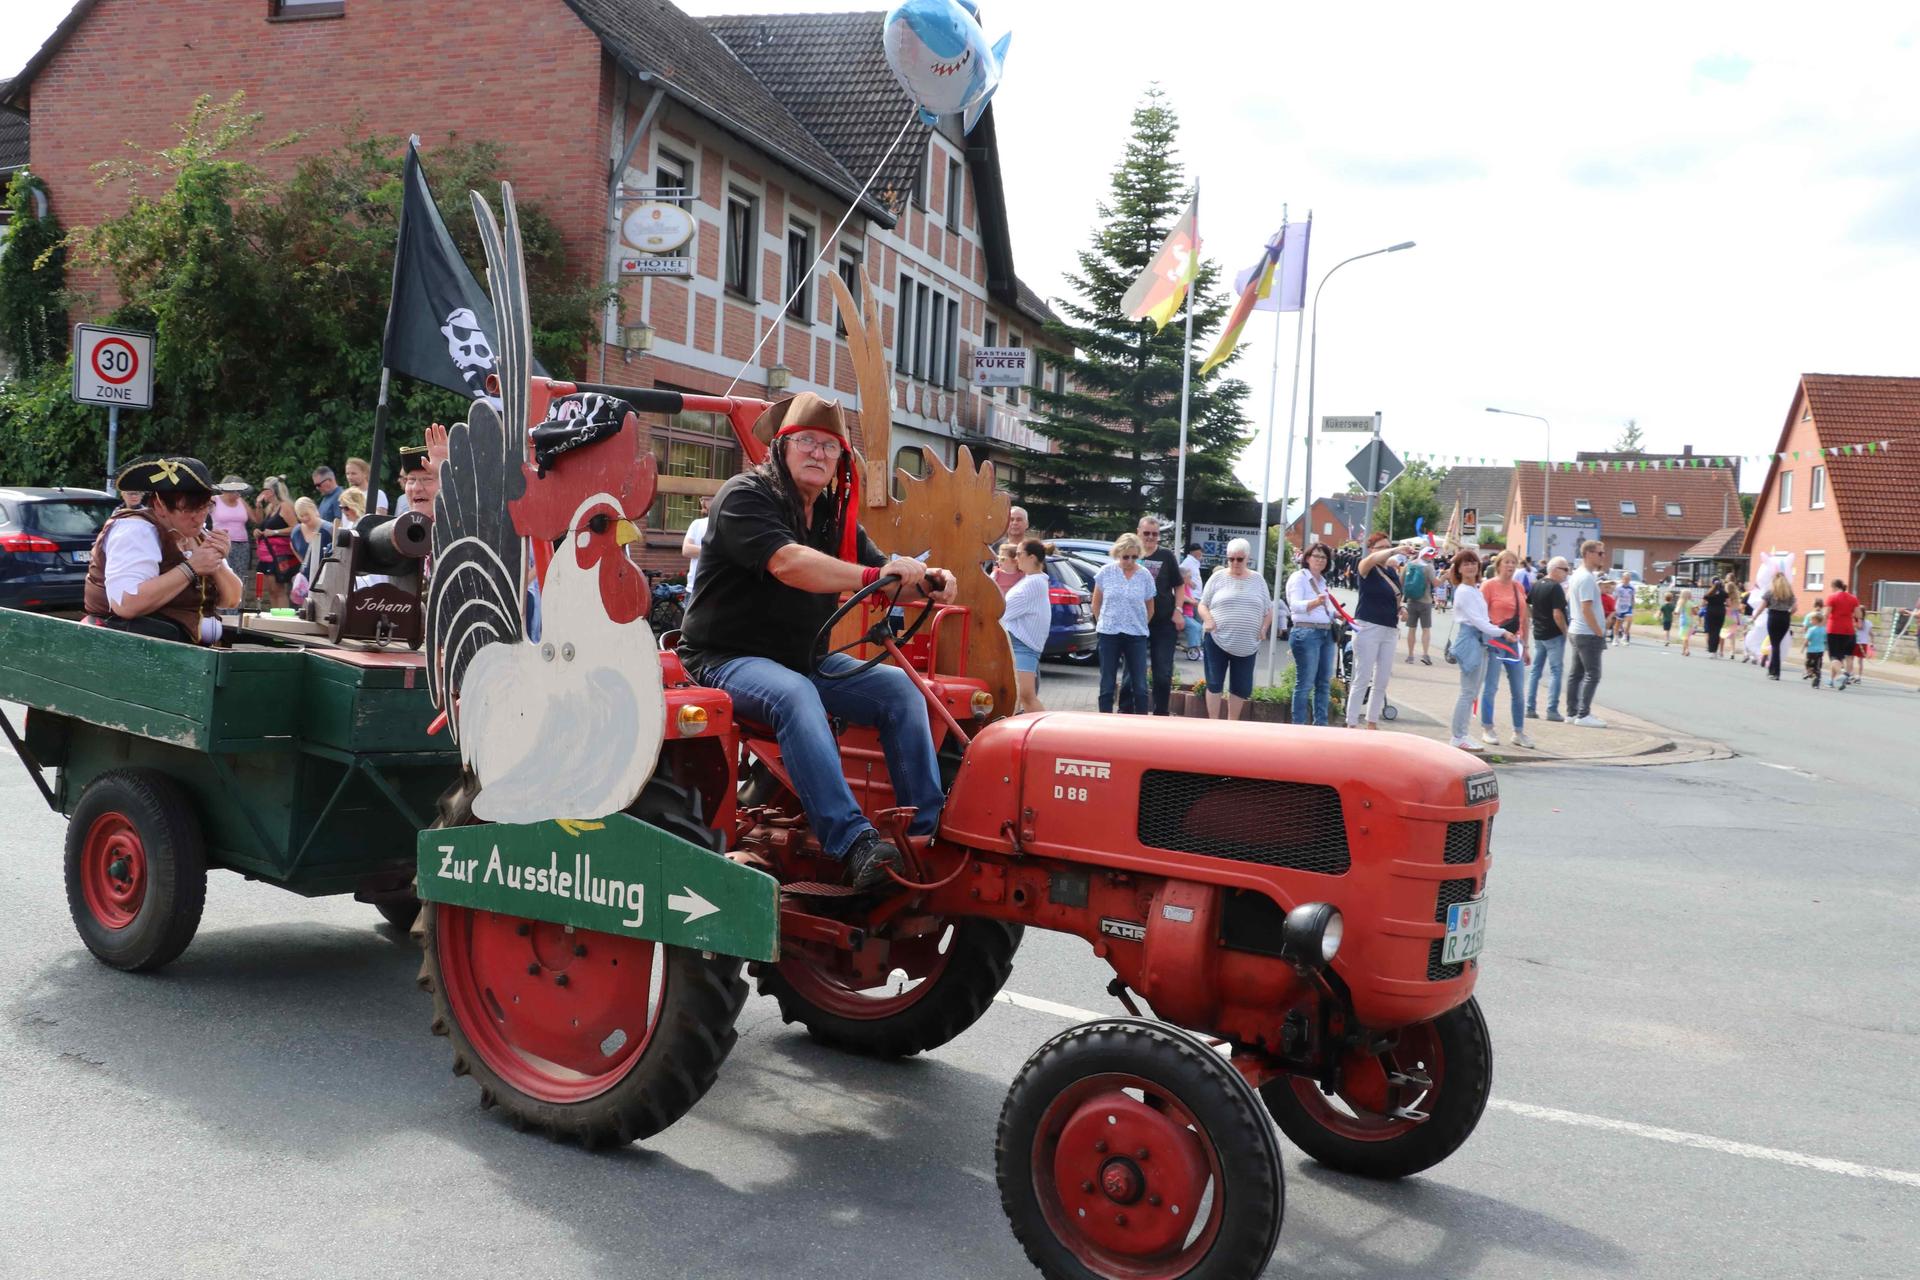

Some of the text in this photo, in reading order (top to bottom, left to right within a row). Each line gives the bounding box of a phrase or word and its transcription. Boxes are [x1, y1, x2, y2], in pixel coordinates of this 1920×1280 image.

[102, 349, 129, 372] 30
[96, 385, 132, 400] ZONE
[1325, 418, 1369, 431] Kükersweg
[355, 597, 412, 613] Johann
[1055, 757, 1111, 780] FAHR
[1054, 785, 1063, 799] D
[1467, 774, 1498, 801] FAHR
[437, 843, 645, 928] Zur Ausstellung
[1101, 919, 1146, 940] FAHR
